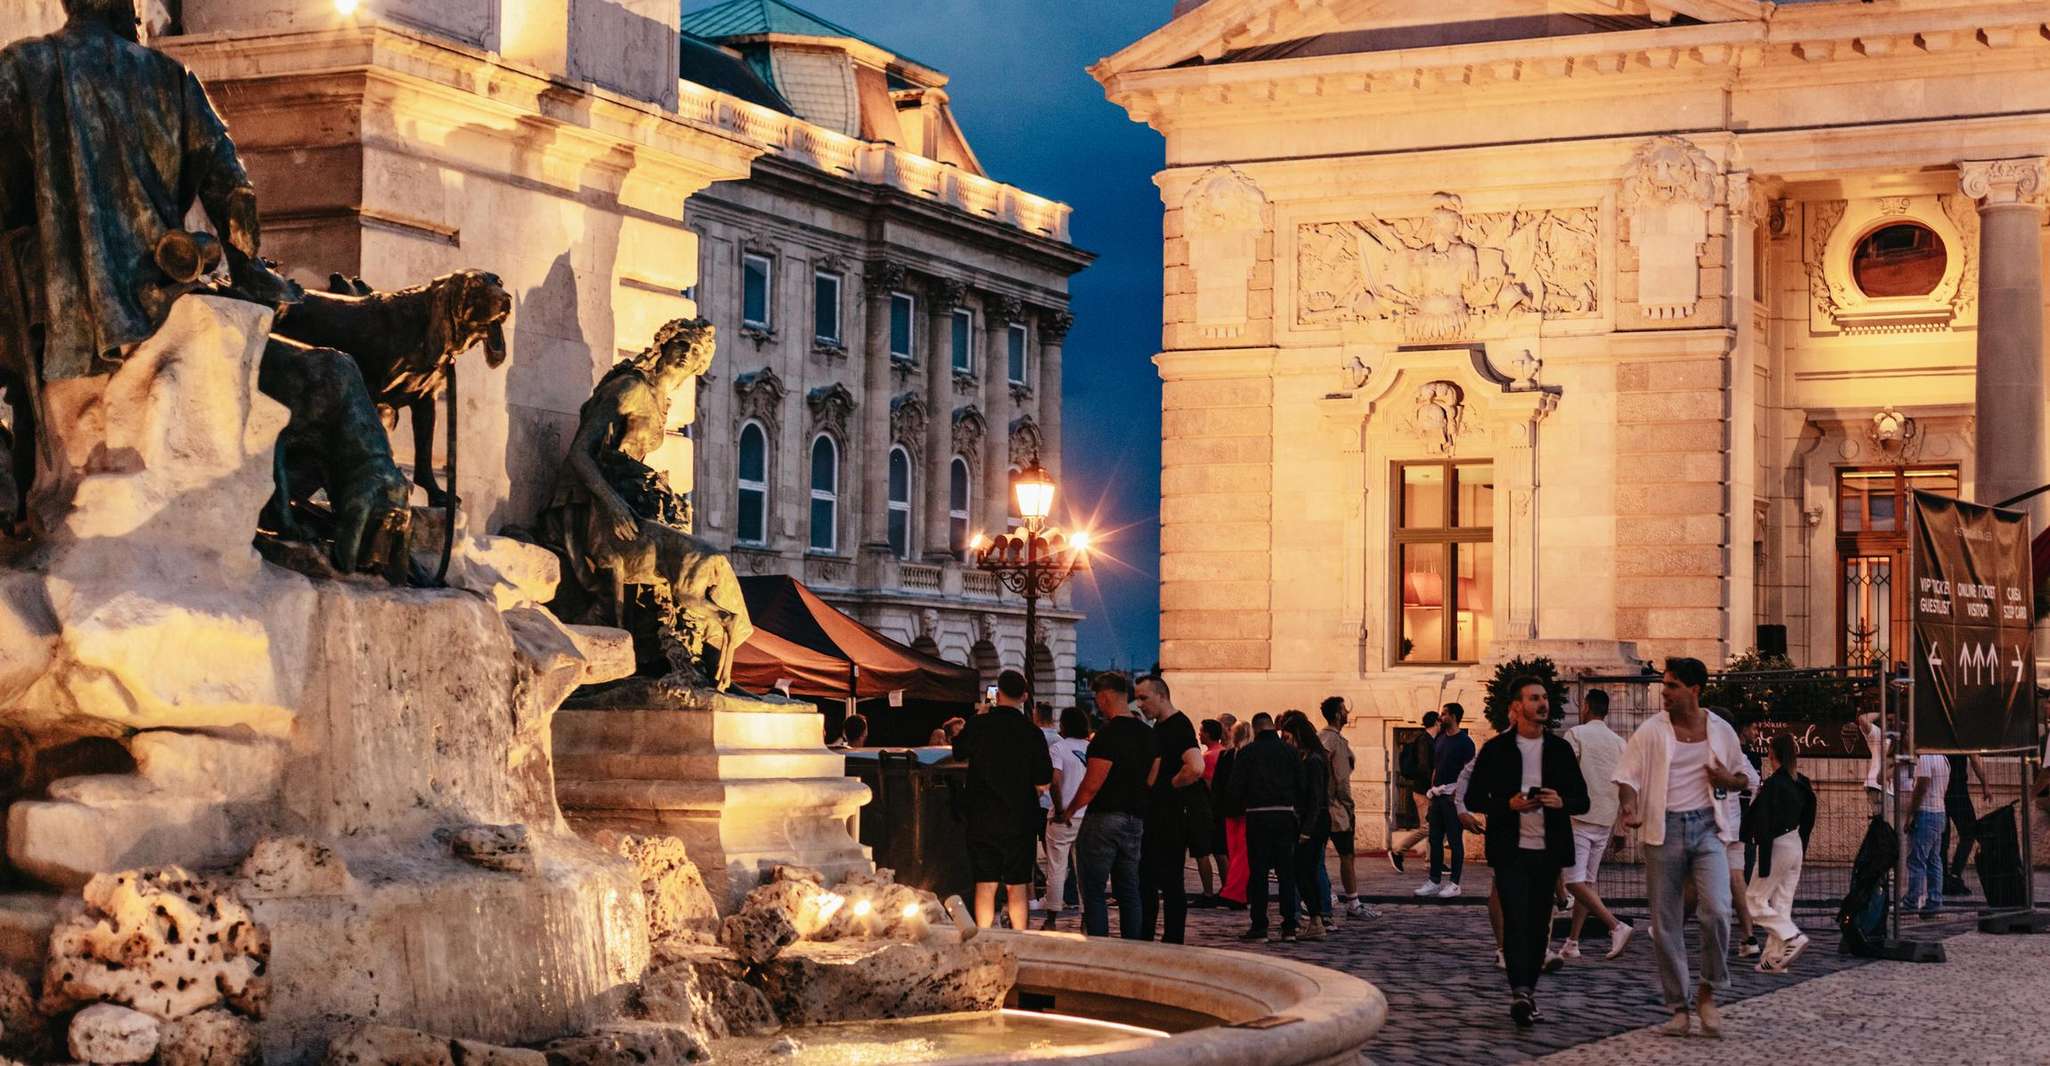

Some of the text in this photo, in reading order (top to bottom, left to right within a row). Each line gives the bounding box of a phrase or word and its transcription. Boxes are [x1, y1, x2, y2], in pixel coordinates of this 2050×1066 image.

[1920, 577, 1931, 592] VIP
[1957, 582, 1996, 600] ONLINE TICKET
[1920, 597, 1951, 615] GUESTLIST
[1967, 602, 1989, 617] VISITOR
